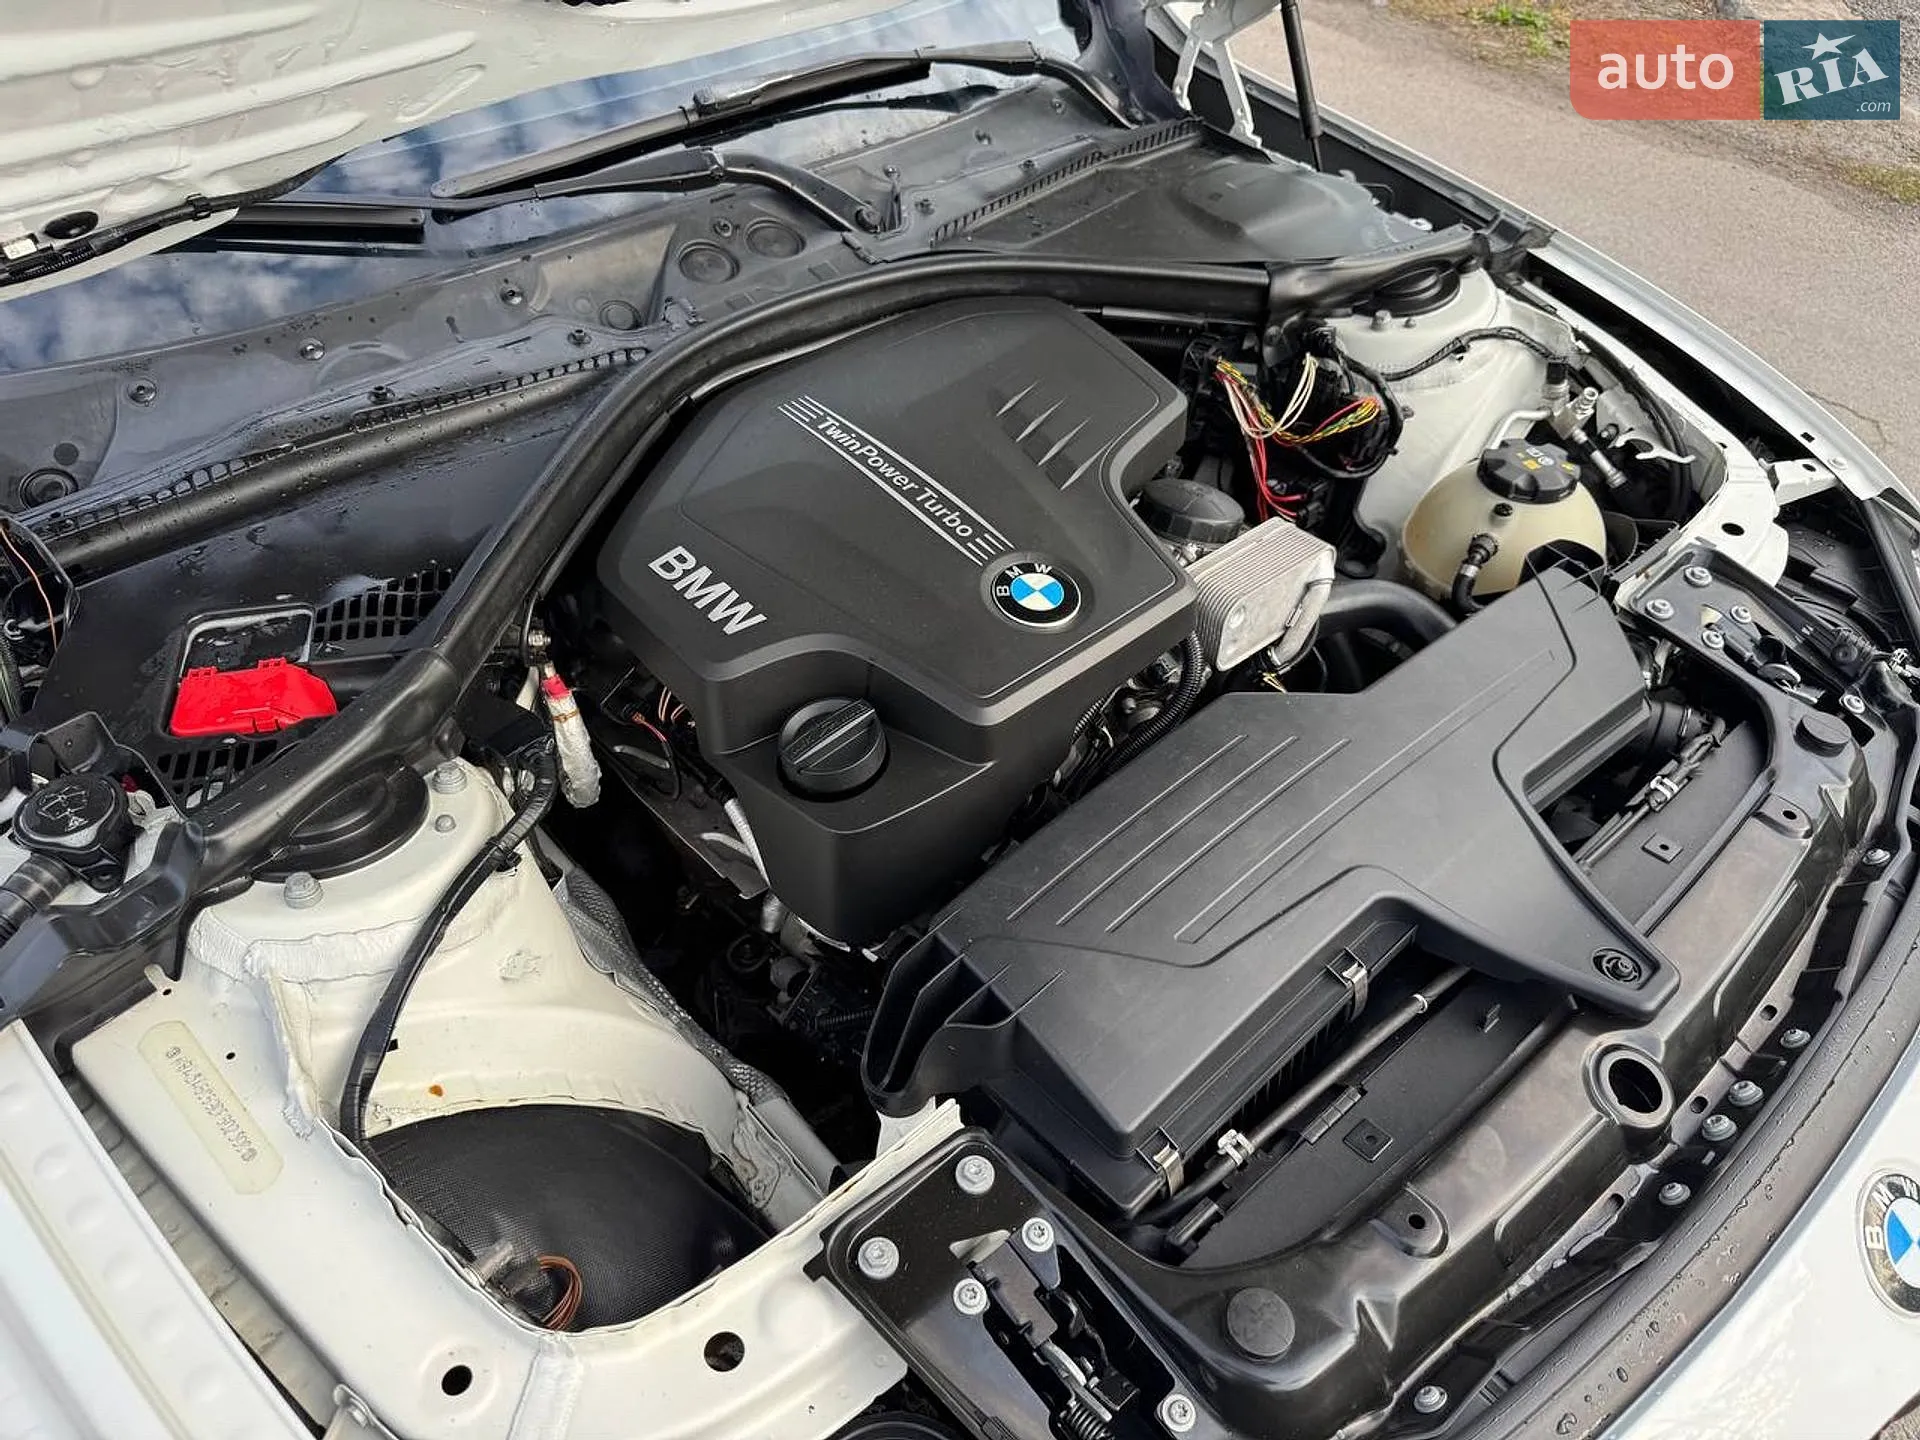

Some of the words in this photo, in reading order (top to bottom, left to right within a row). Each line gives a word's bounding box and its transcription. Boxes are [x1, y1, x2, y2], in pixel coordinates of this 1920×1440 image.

[816, 416, 918, 491] TwinPower
[916, 487, 973, 537] Turbo
[648, 545, 767, 635] BMW
[996, 563, 1052, 597] BMW
[1865, 1176, 1919, 1250] BMW
